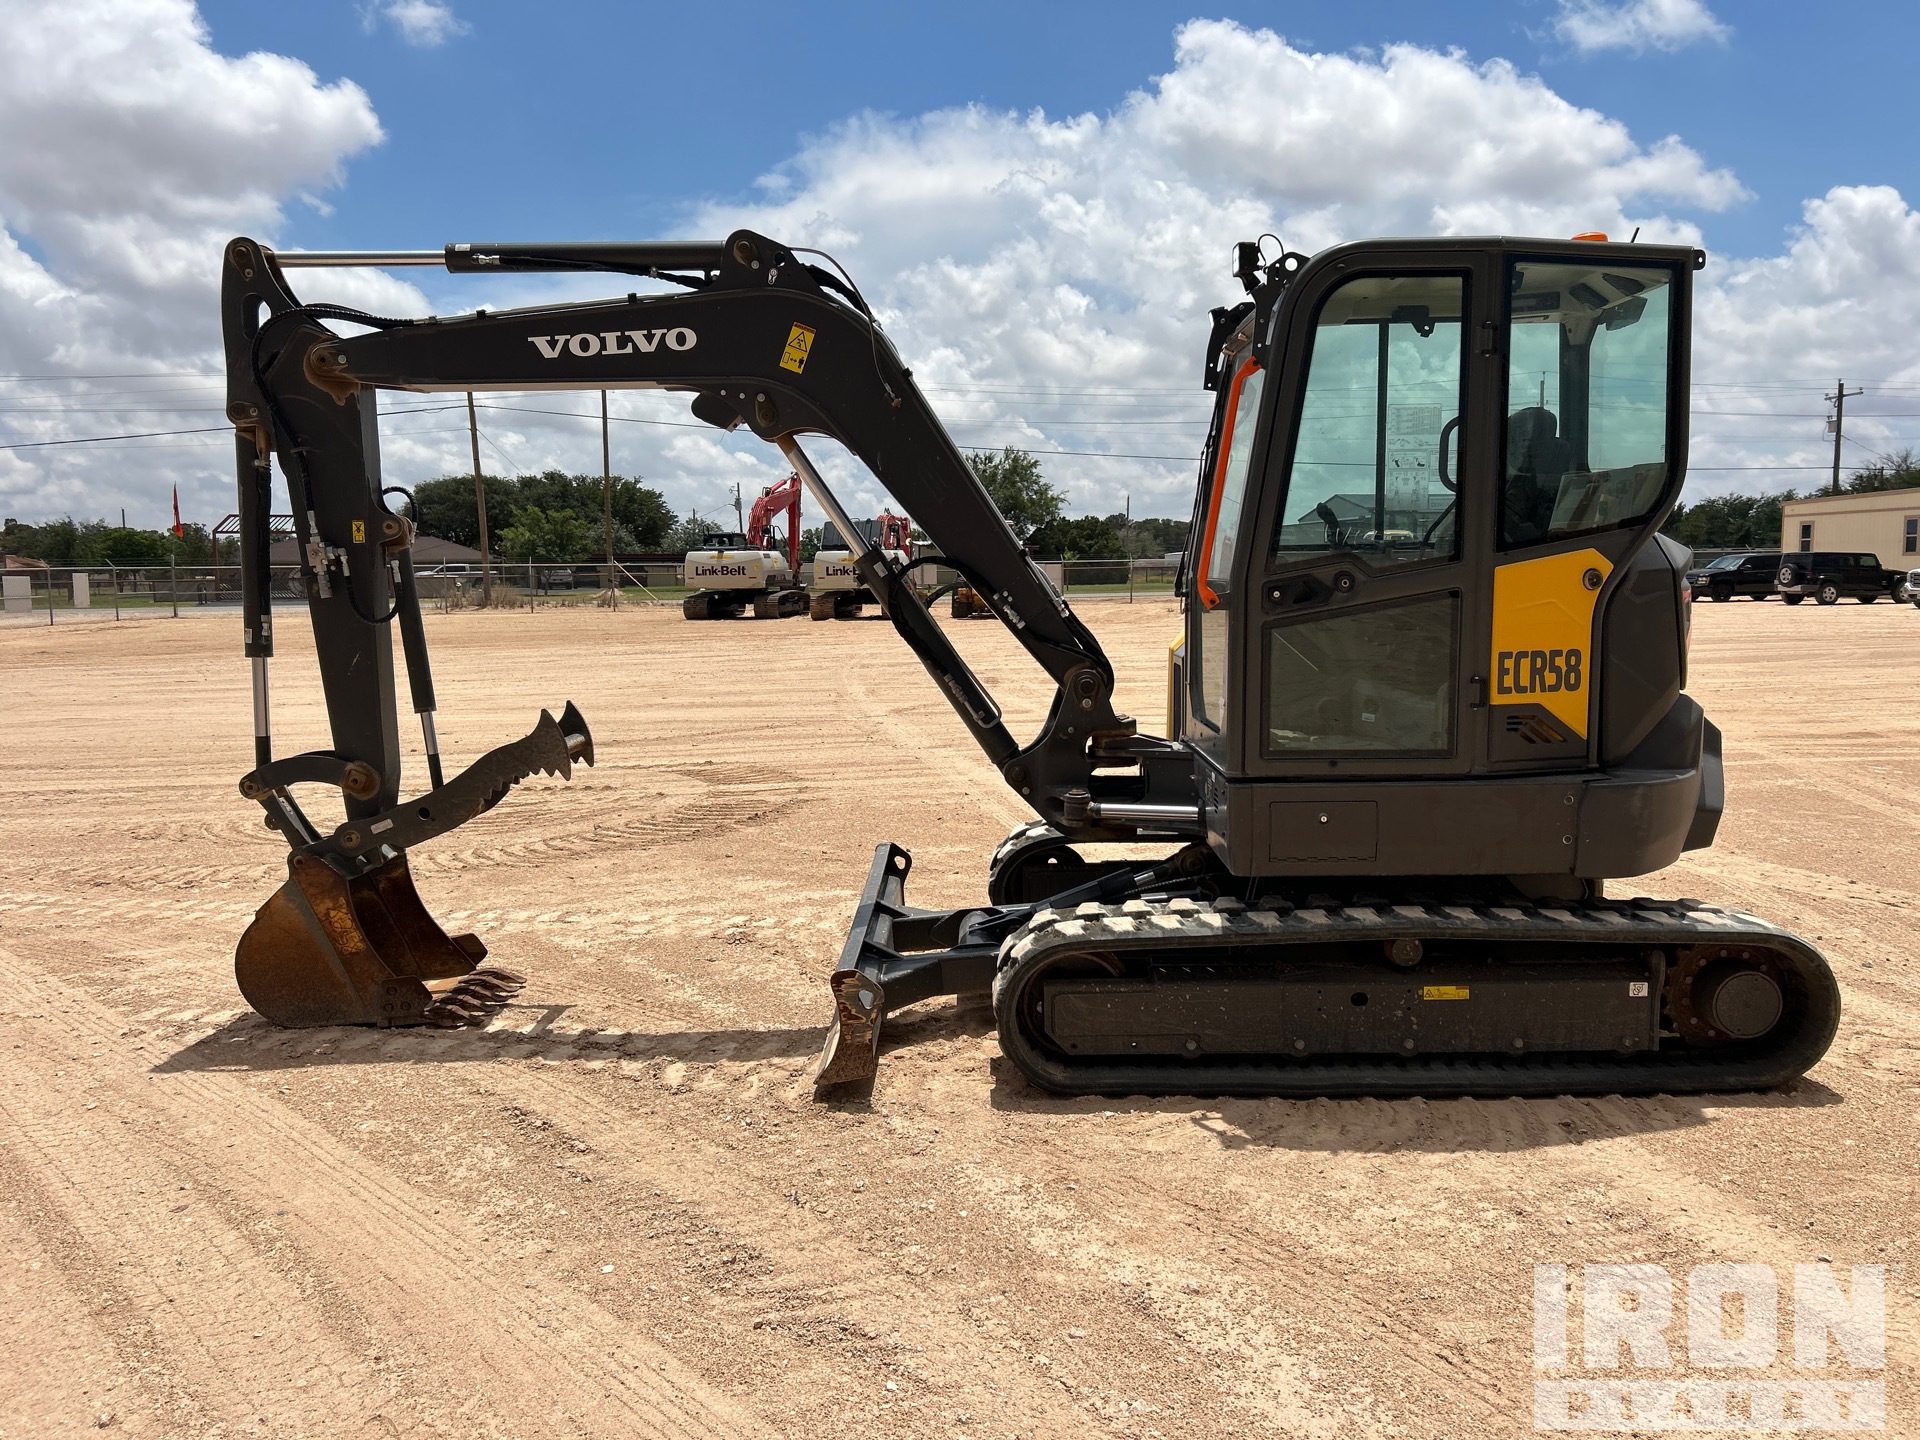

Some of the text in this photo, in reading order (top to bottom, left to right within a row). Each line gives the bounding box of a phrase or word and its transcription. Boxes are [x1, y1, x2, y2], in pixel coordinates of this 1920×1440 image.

[528, 327, 697, 358] VOLVO
[695, 566, 747, 576] Link-Belt
[1497, 649, 1582, 695] ECR58
